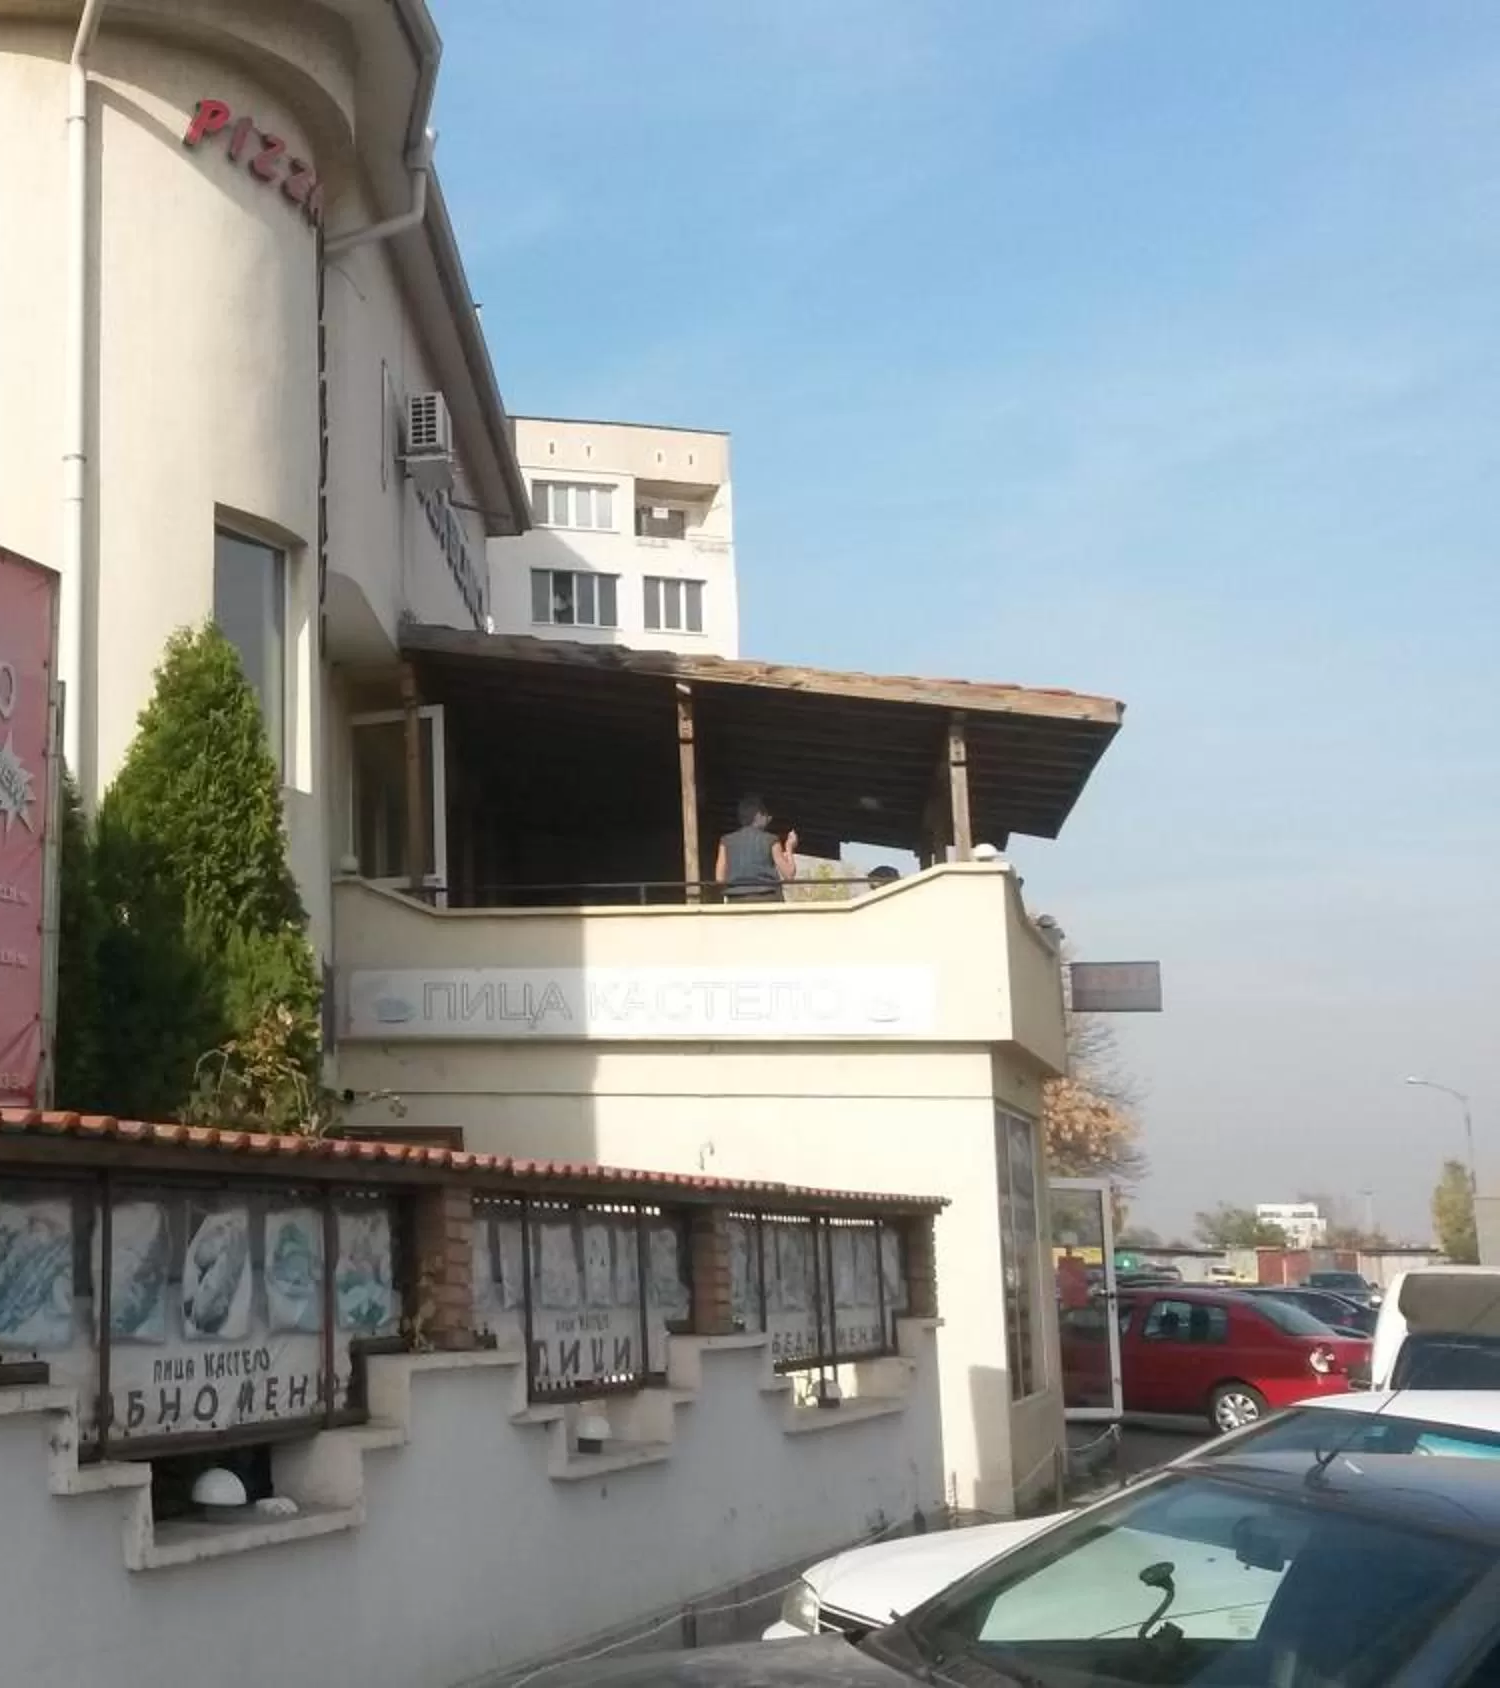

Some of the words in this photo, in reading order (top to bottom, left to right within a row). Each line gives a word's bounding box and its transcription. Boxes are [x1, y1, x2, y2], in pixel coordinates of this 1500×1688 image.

[422, 980, 573, 1028] ПИЦА
[588, 979, 844, 1022] КАСТЕЛО
[153, 1358, 196, 1385] ПИЦА
[203, 1347, 271, 1380] КАСТЕЛО
